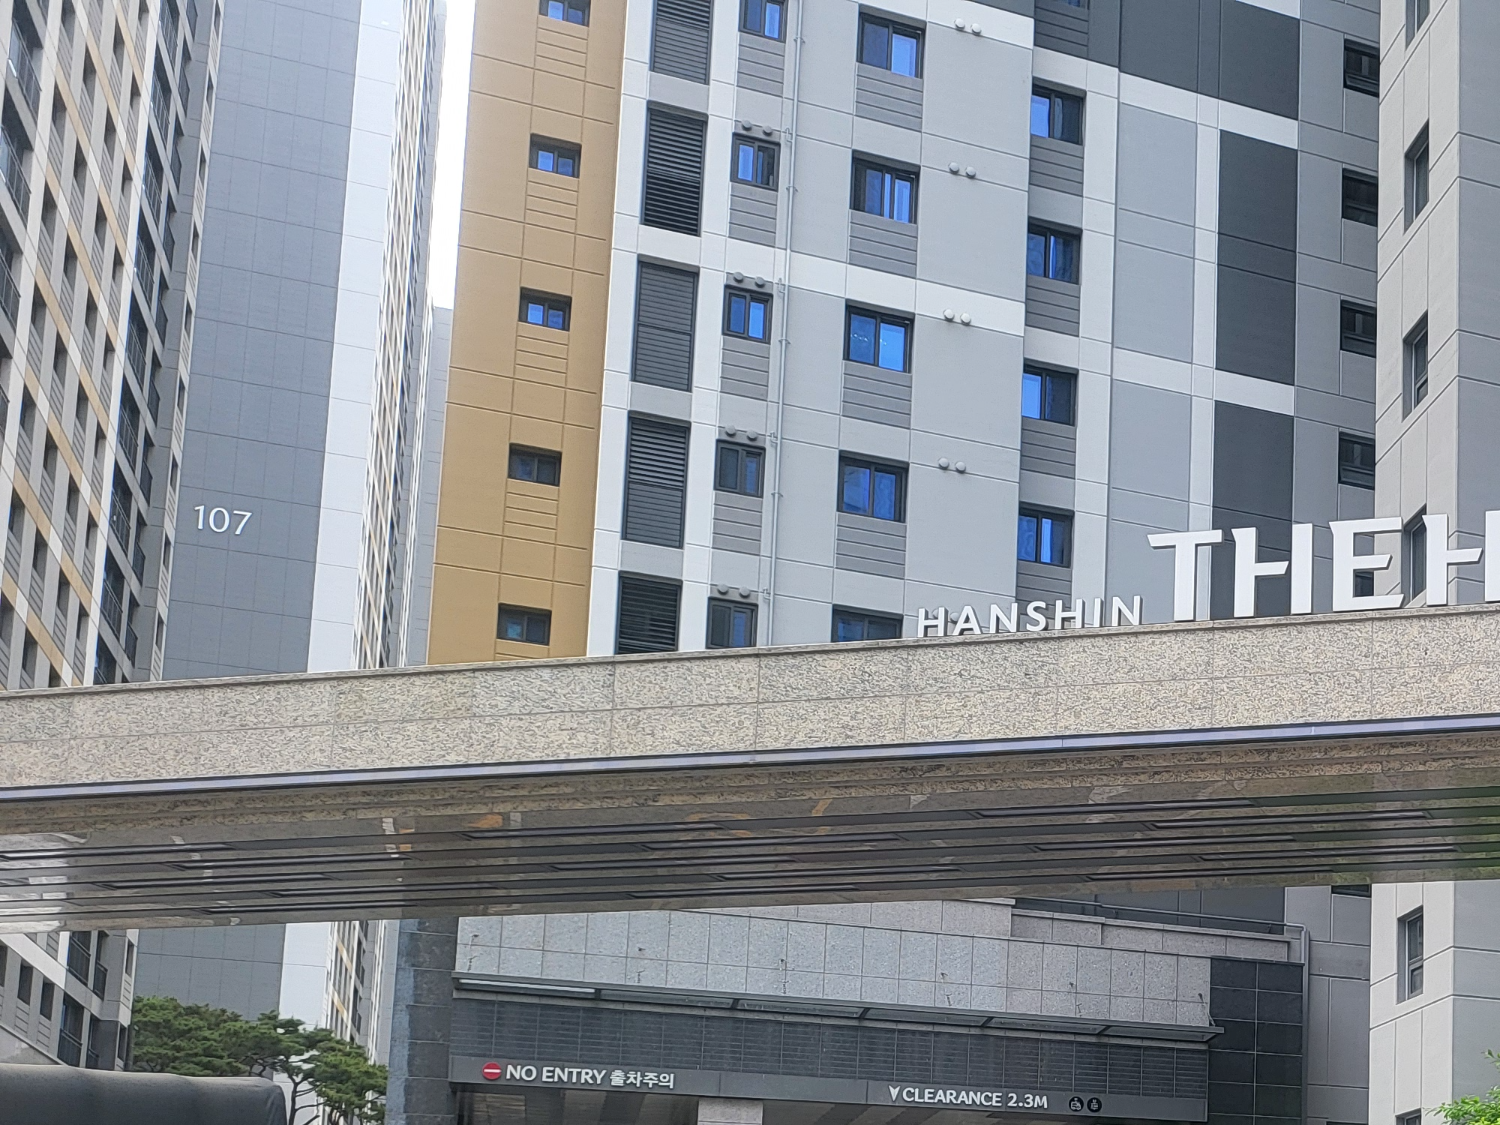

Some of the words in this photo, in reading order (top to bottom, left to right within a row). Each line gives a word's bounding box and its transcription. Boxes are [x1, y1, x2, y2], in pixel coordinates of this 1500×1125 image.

[194, 505, 253, 535] 107
[917, 594, 1141, 638] HANSHIN
[506, 1065, 537, 1081] NO
[541, 1067, 607, 1085] ENTRY
[609, 1070, 675, 1089] 출차주의
[902, 1087, 1002, 1107] CLEARANCE
[1007, 1093, 1048, 1109] 2.3M
